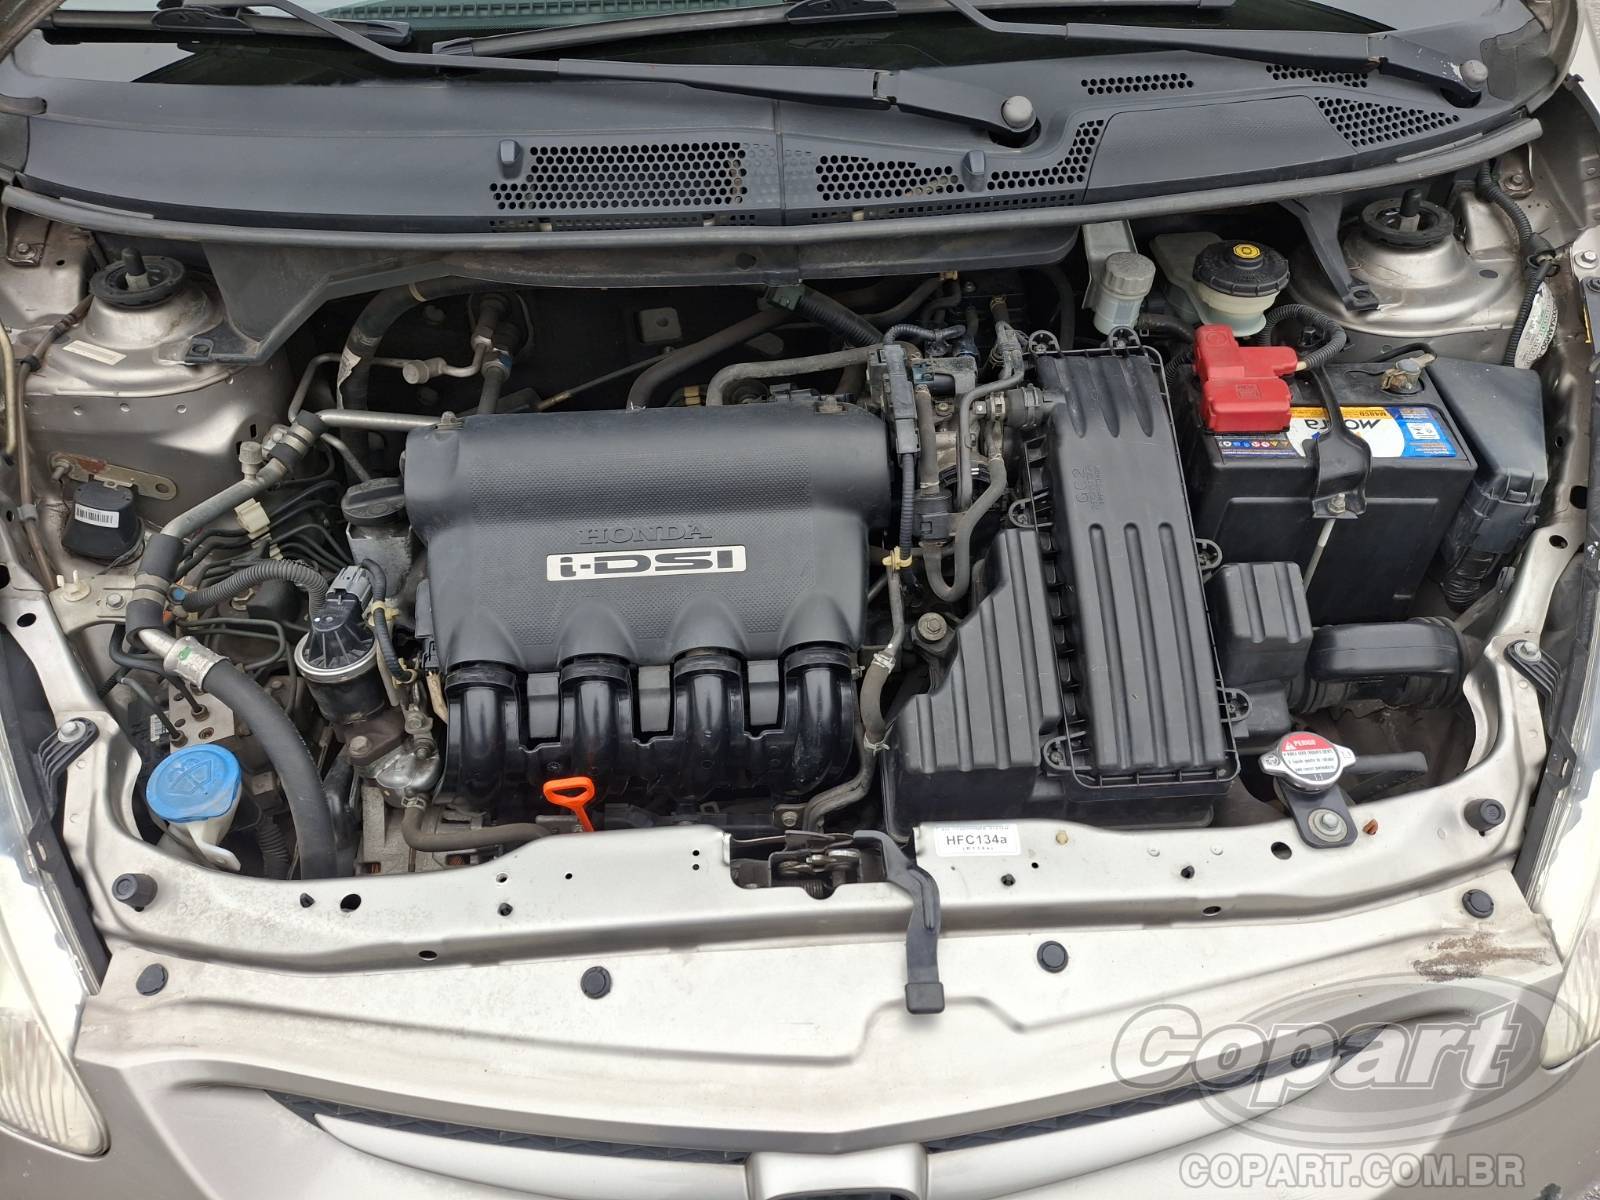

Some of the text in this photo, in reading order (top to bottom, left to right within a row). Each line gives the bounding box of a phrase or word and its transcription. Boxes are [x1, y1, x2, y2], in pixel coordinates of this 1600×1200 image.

[1304, 418, 1382, 430] Mora
[579, 525, 712, 544] HONDA
[560, 550, 733, 577] i-DSI
[946, 834, 1007, 845] HFC134a
